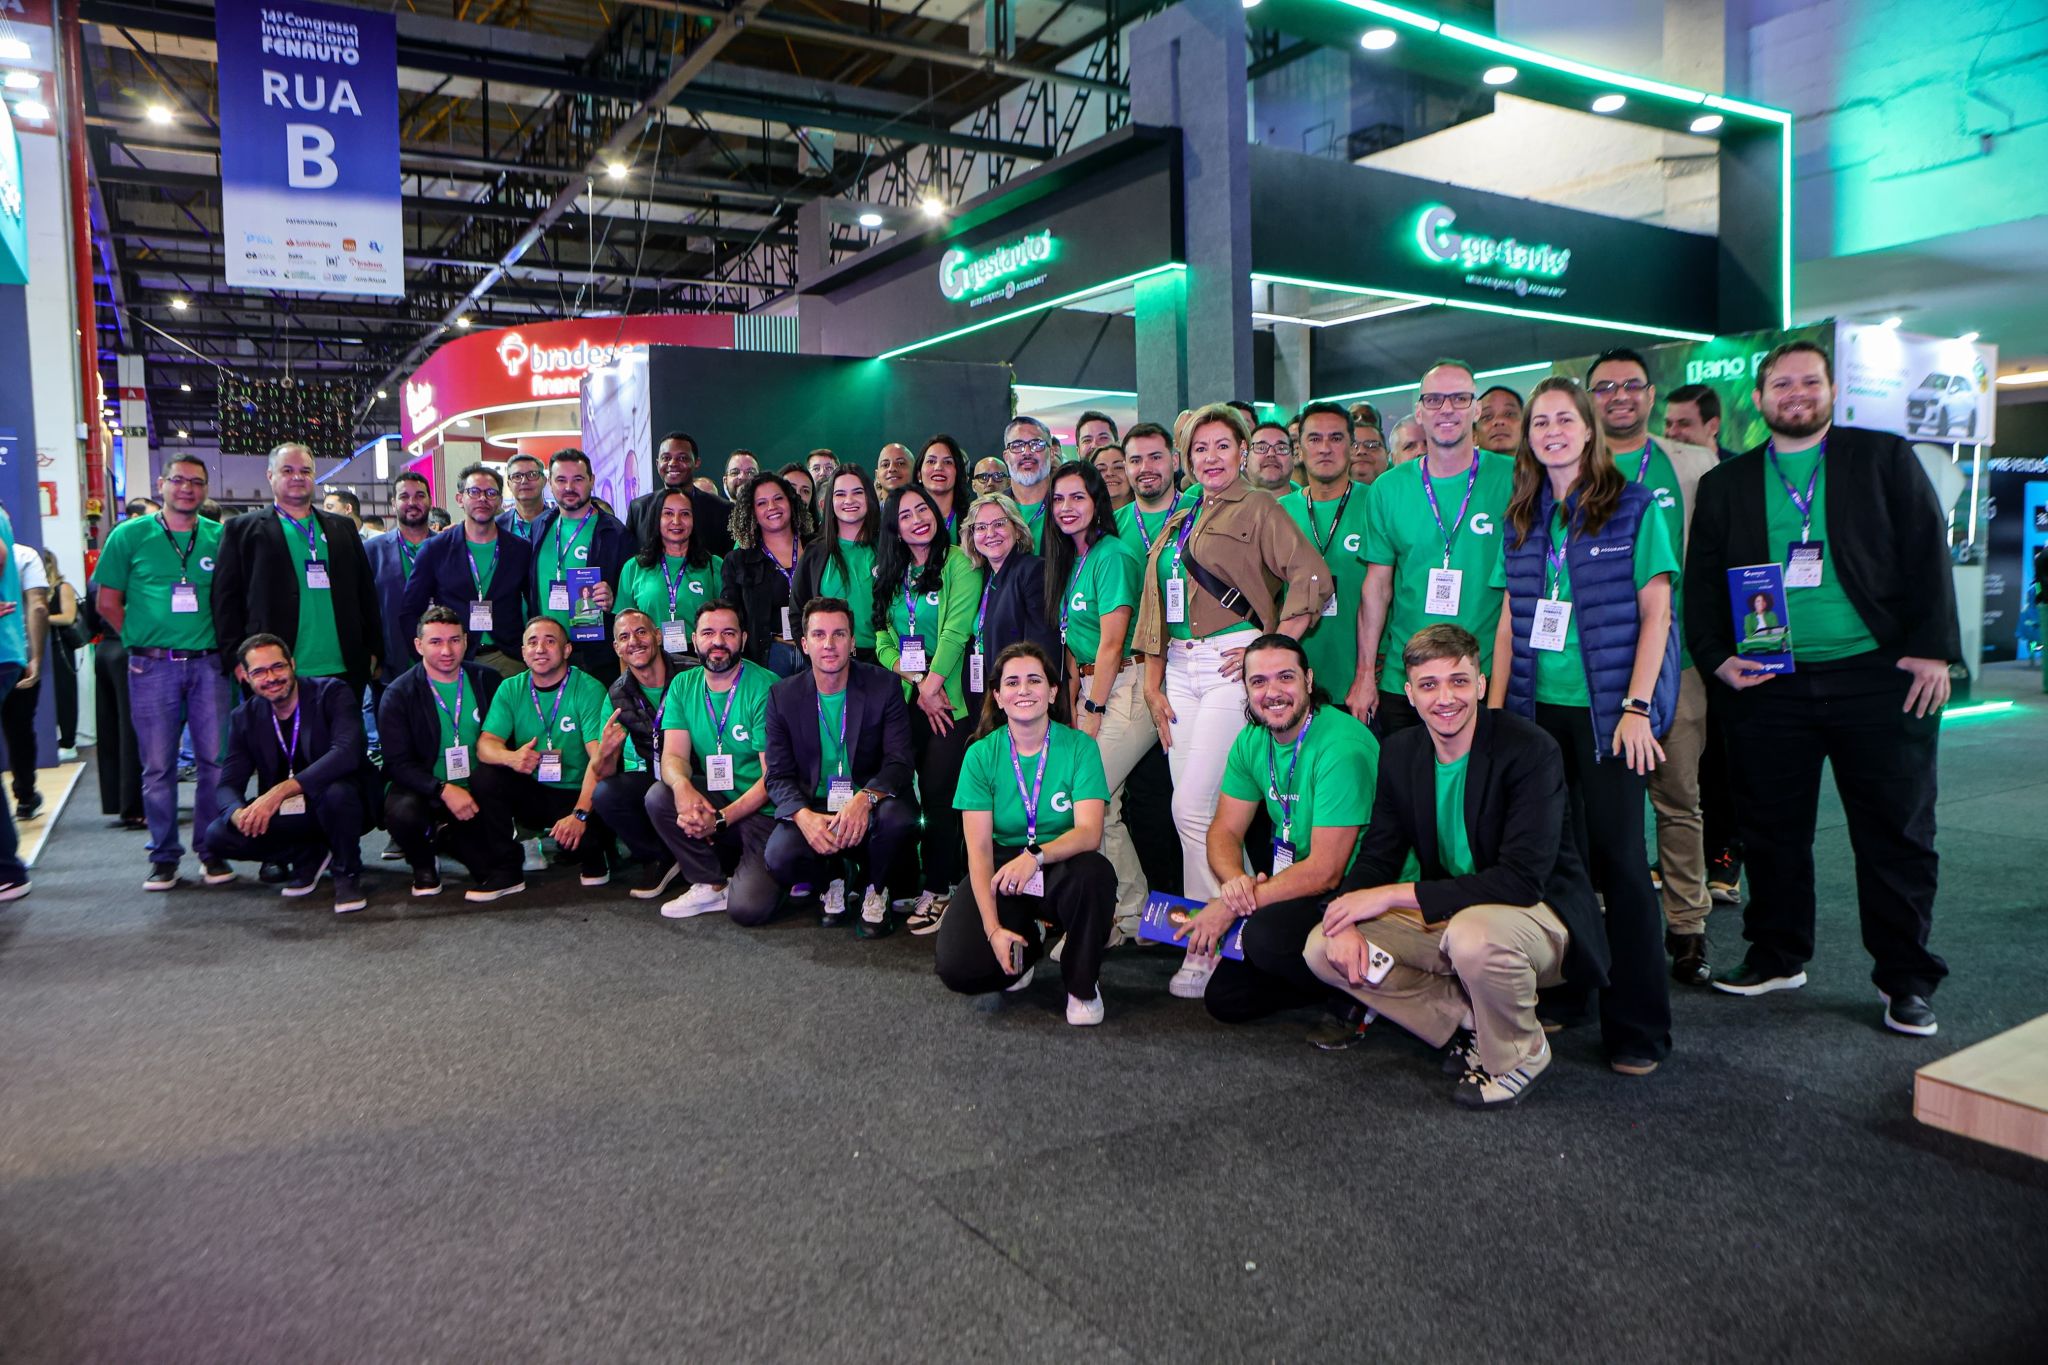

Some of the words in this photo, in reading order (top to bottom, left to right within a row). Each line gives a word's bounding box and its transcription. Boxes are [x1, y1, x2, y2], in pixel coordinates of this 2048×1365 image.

[262, 20, 359, 48] Internacional
[285, 11, 358, 35] Congresso
[262, 35, 360, 66] FENAUTO
[263, 69, 362, 116] RUA
[287, 123, 338, 189] B
[1470, 513, 1494, 535] G
[1344, 534, 1360, 551] G
[1071, 592, 1087, 611] G
[560, 716, 576, 732] G
[732, 725, 749, 741] G
[1051, 791, 1073, 812] G
